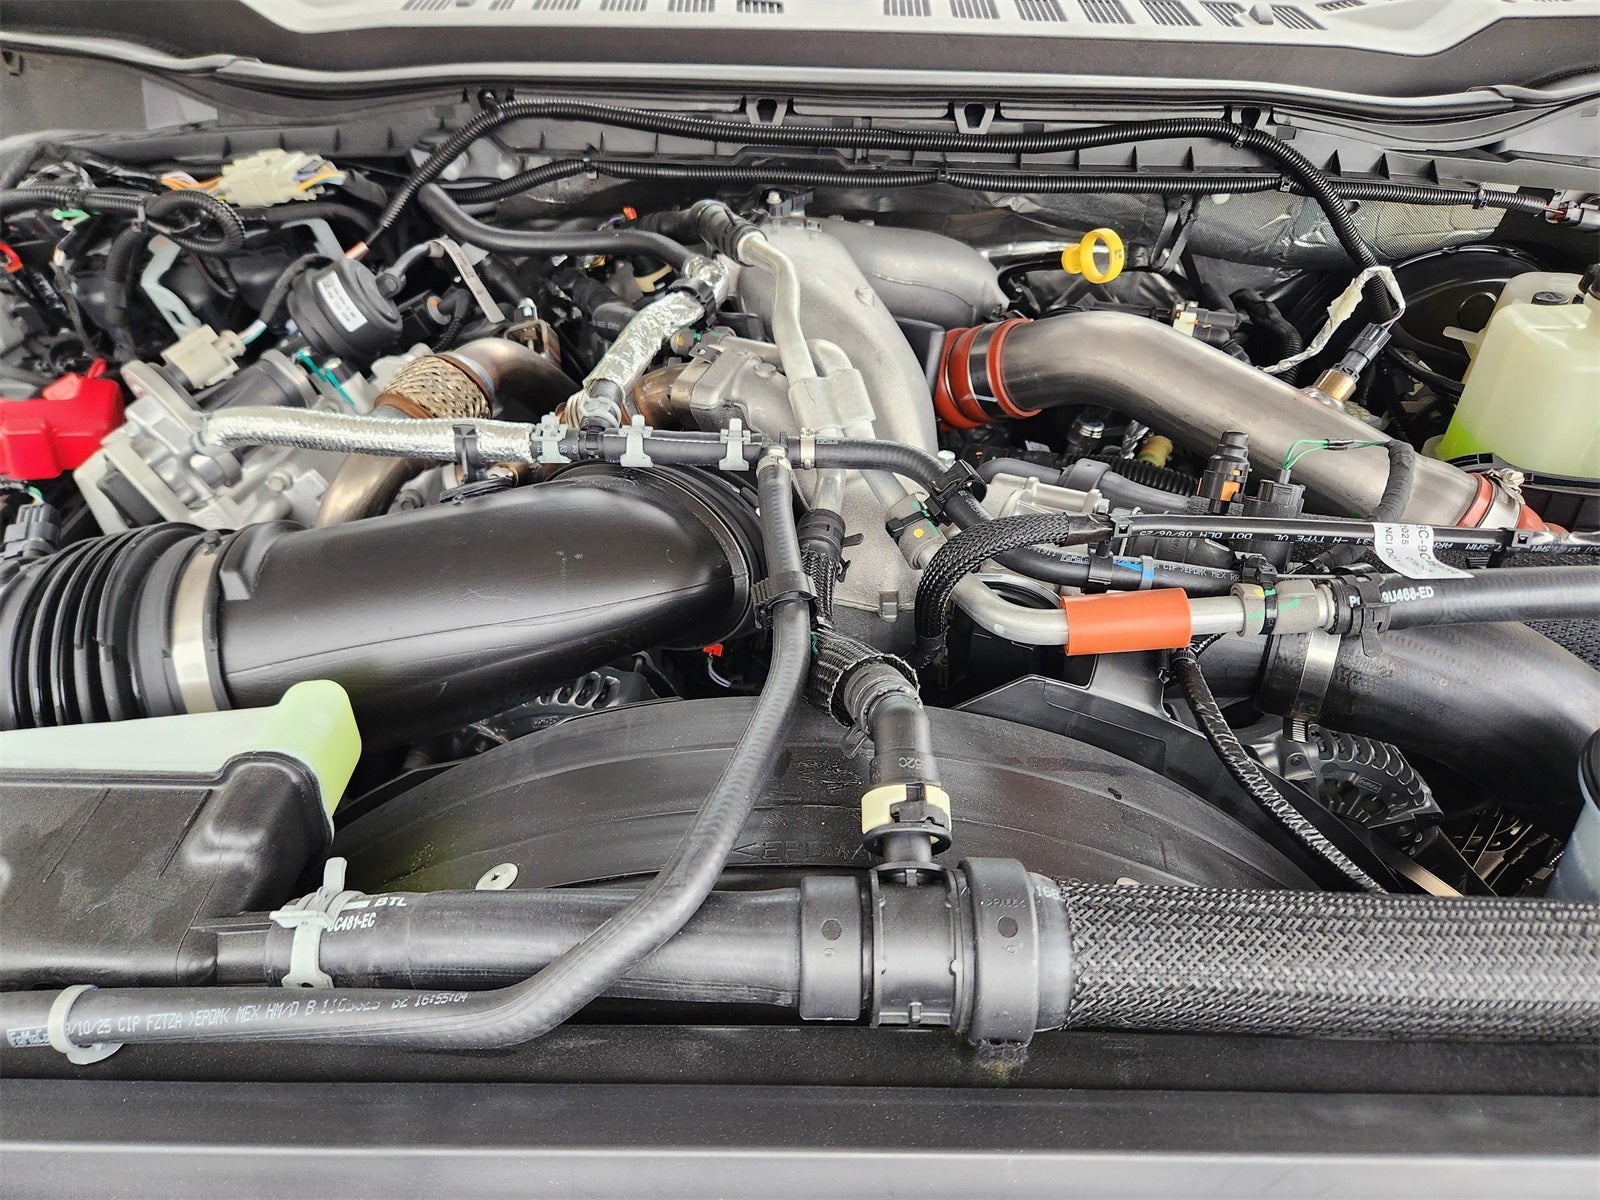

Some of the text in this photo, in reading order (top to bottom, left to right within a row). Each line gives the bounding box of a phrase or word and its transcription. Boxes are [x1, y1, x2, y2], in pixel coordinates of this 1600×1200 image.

[1230, 532, 1253, 540] DOT
[1297, 534, 1325, 543] TYPE
[374, 896, 407, 907] BTL
[117, 1015, 140, 1032] CIP
[236, 1004, 261, 1023] MEX
[304, 1000, 316, 1016] B
